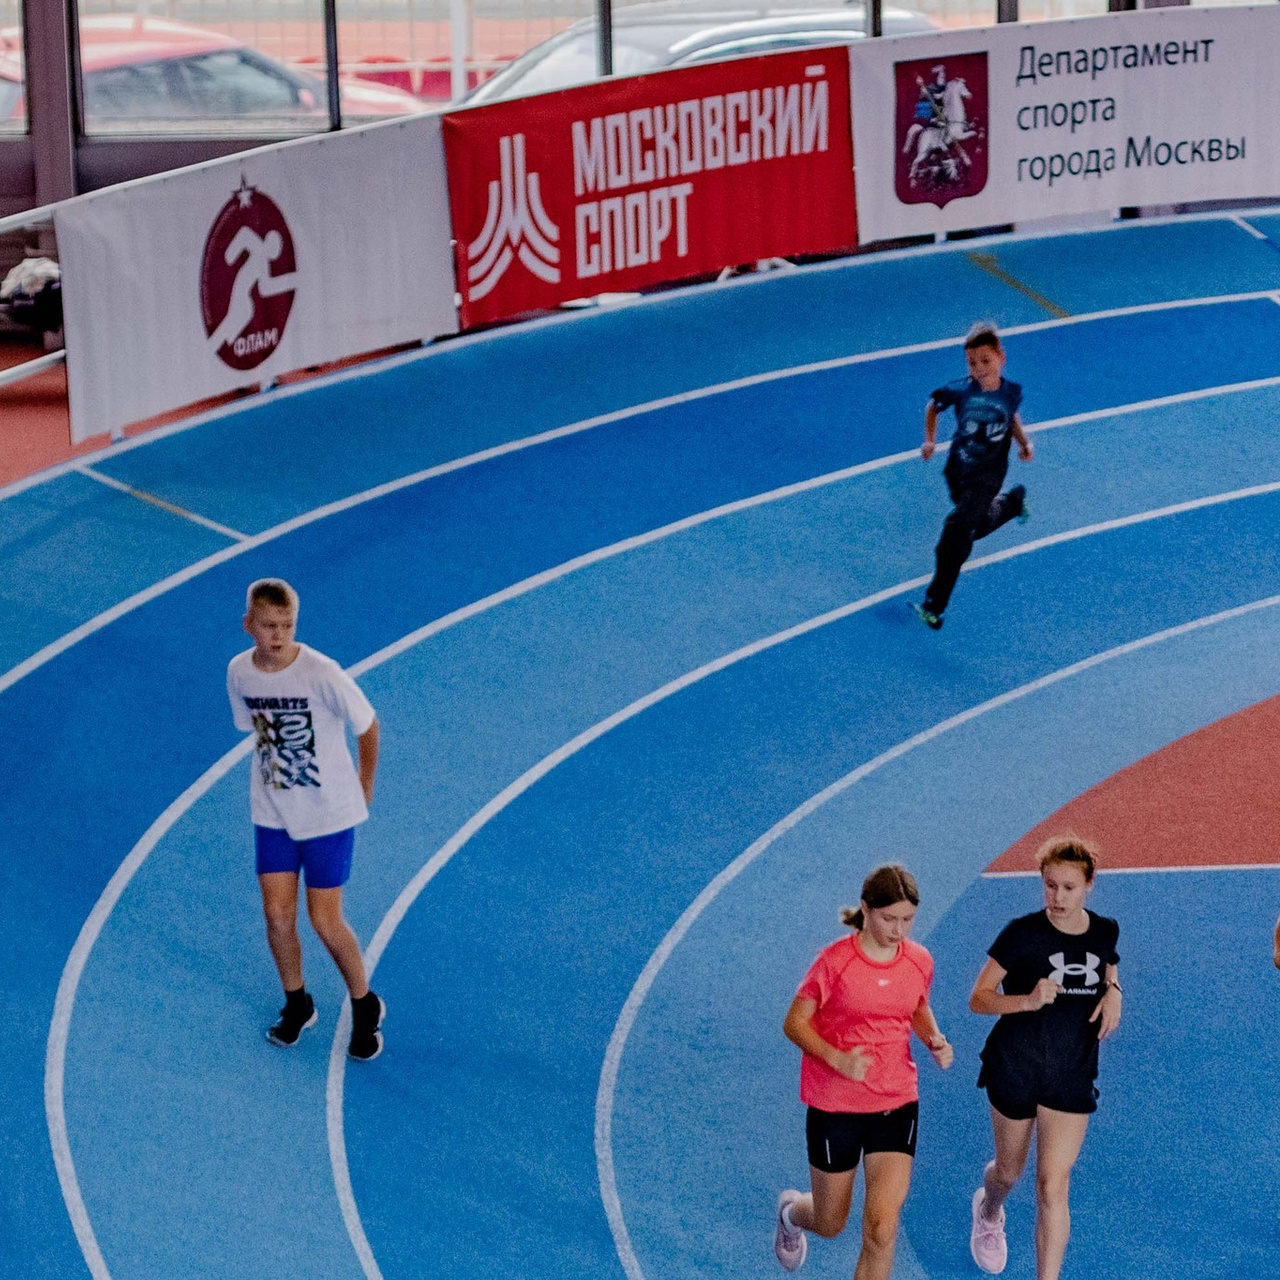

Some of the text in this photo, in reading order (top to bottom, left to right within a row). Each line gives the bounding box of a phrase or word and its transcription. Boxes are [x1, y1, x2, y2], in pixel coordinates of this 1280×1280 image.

[1016, 39, 1214, 87] Департамент
[571, 64, 829, 197] МОСКОВСКИЙ
[1016, 97, 1116, 133] спорта
[1017, 135, 1246, 187] города Москвы
[575, 182, 694, 279] СПОРТ
[233, 327, 278, 356] ФЛАМ
